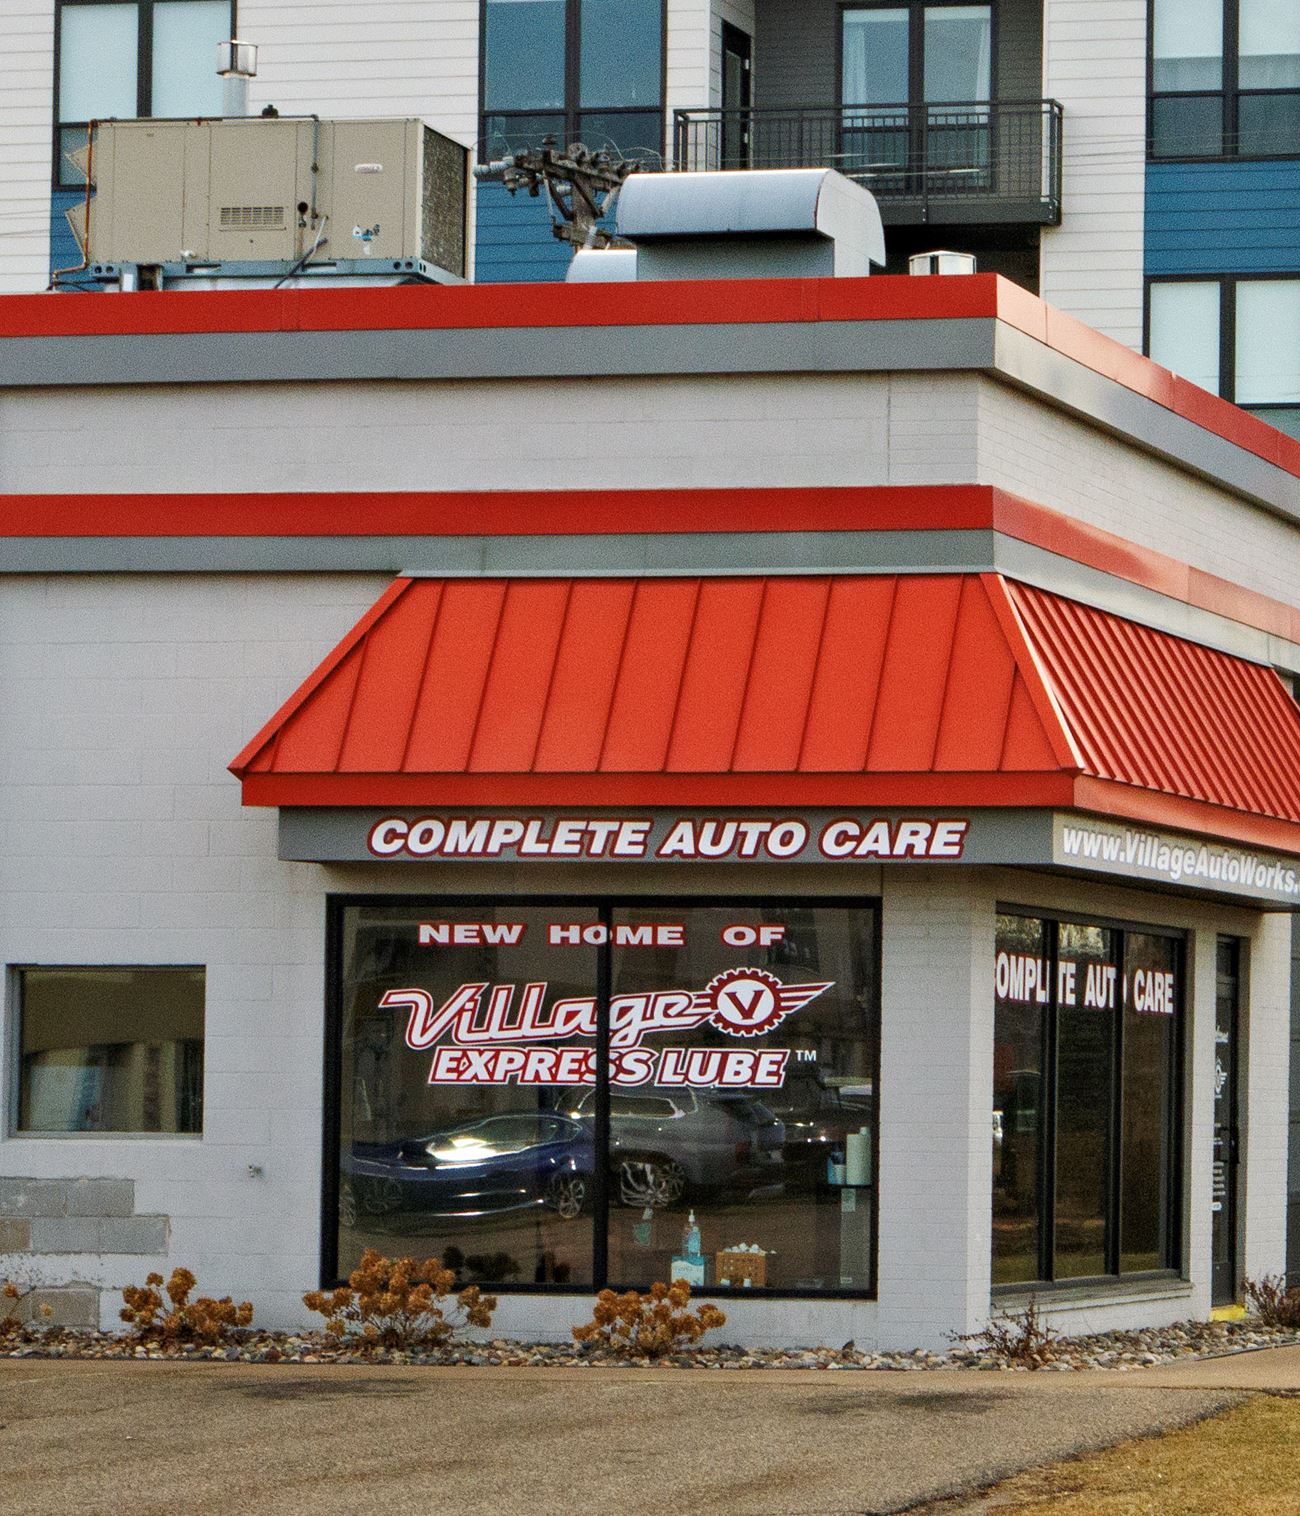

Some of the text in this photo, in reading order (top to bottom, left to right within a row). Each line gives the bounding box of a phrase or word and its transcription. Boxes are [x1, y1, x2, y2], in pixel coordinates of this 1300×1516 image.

[369, 818, 970, 859] COMPLETE AUTO CARE
[418, 923, 786, 947] NEW HOME OF
[994, 950, 1175, 1014] OMPLTE AUT CARE
[378, 981, 716, 1048] Village
[428, 1046, 658, 1086] EXPRESS
[655, 1049, 790, 1089] LUBE
